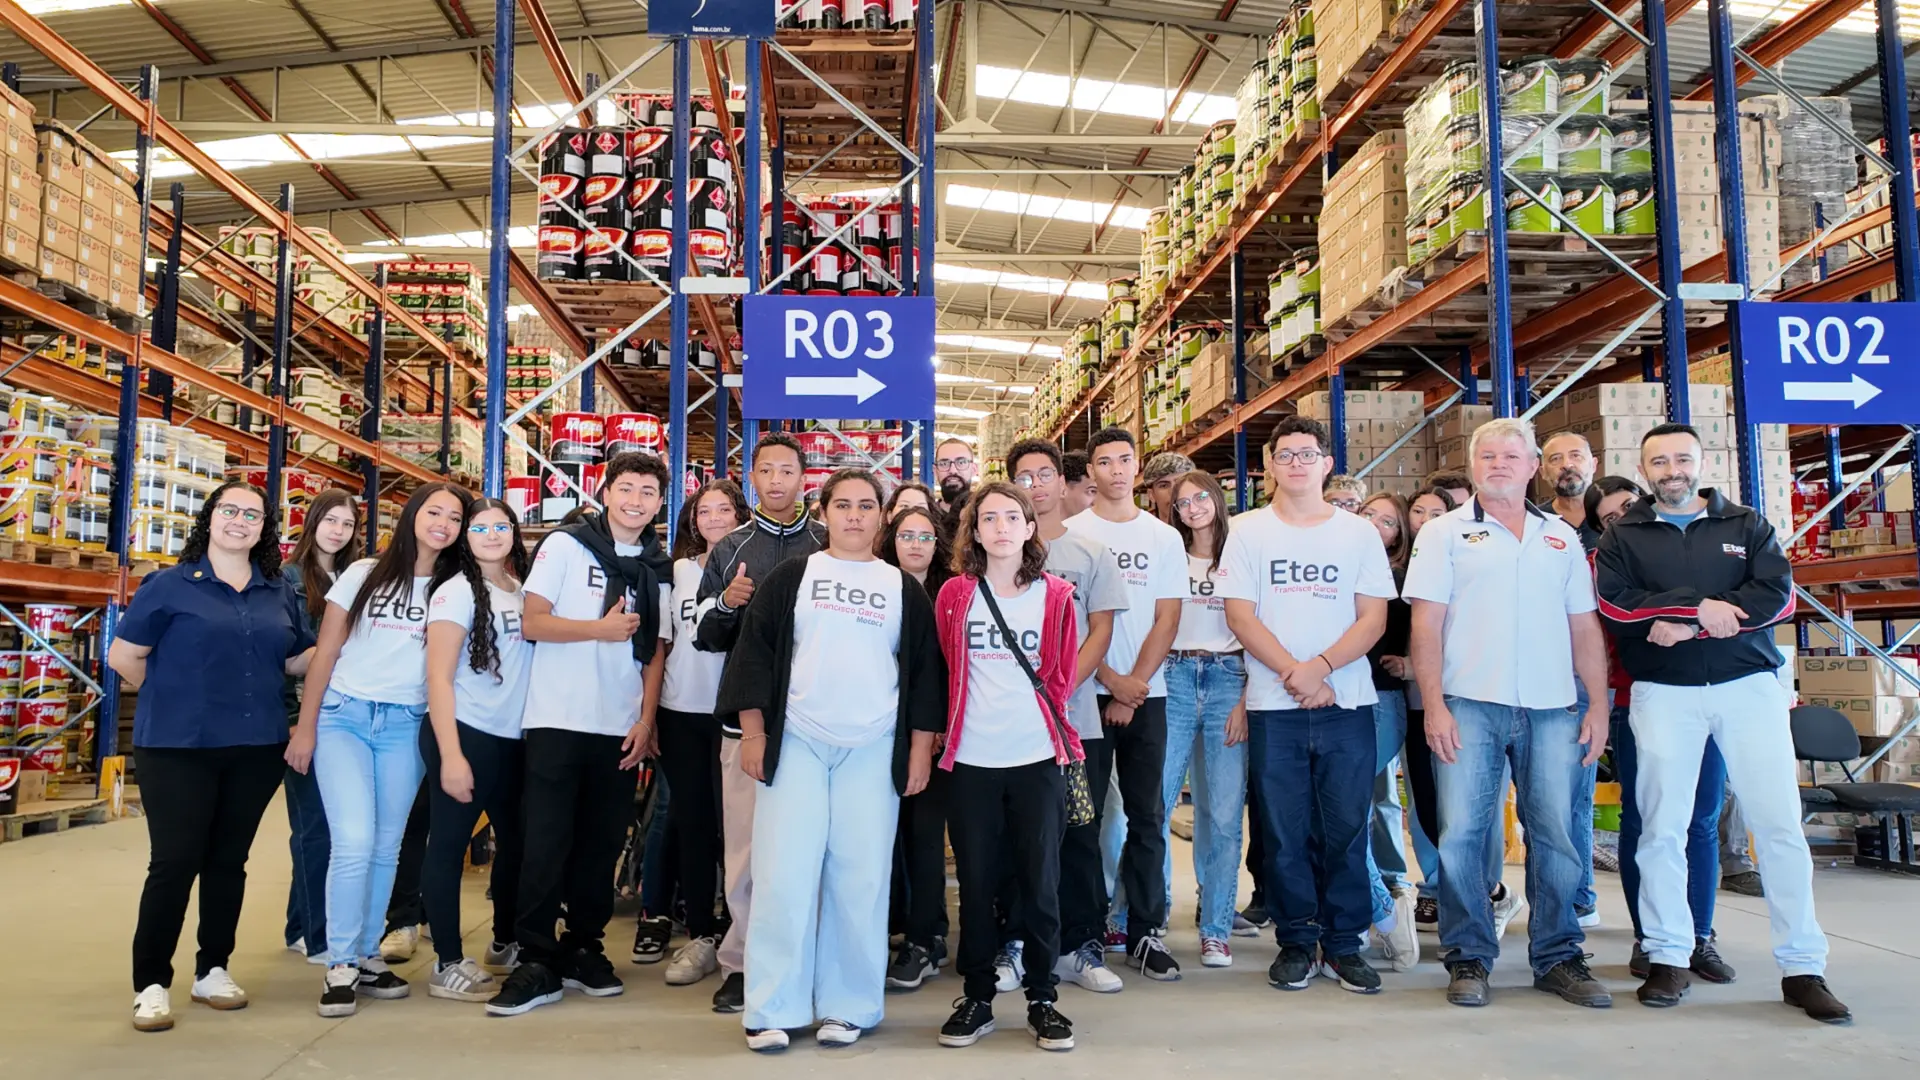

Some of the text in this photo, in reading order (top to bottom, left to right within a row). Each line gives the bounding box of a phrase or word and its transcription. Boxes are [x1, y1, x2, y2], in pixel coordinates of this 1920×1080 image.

[785, 310, 895, 359] R03
[1778, 316, 1890, 365] R02
[1270, 559, 1339, 585] Etec
[811, 579, 887, 610] Etec
[1274, 585, 1312, 594] Francisco
[814, 601, 856, 614] Francisco
